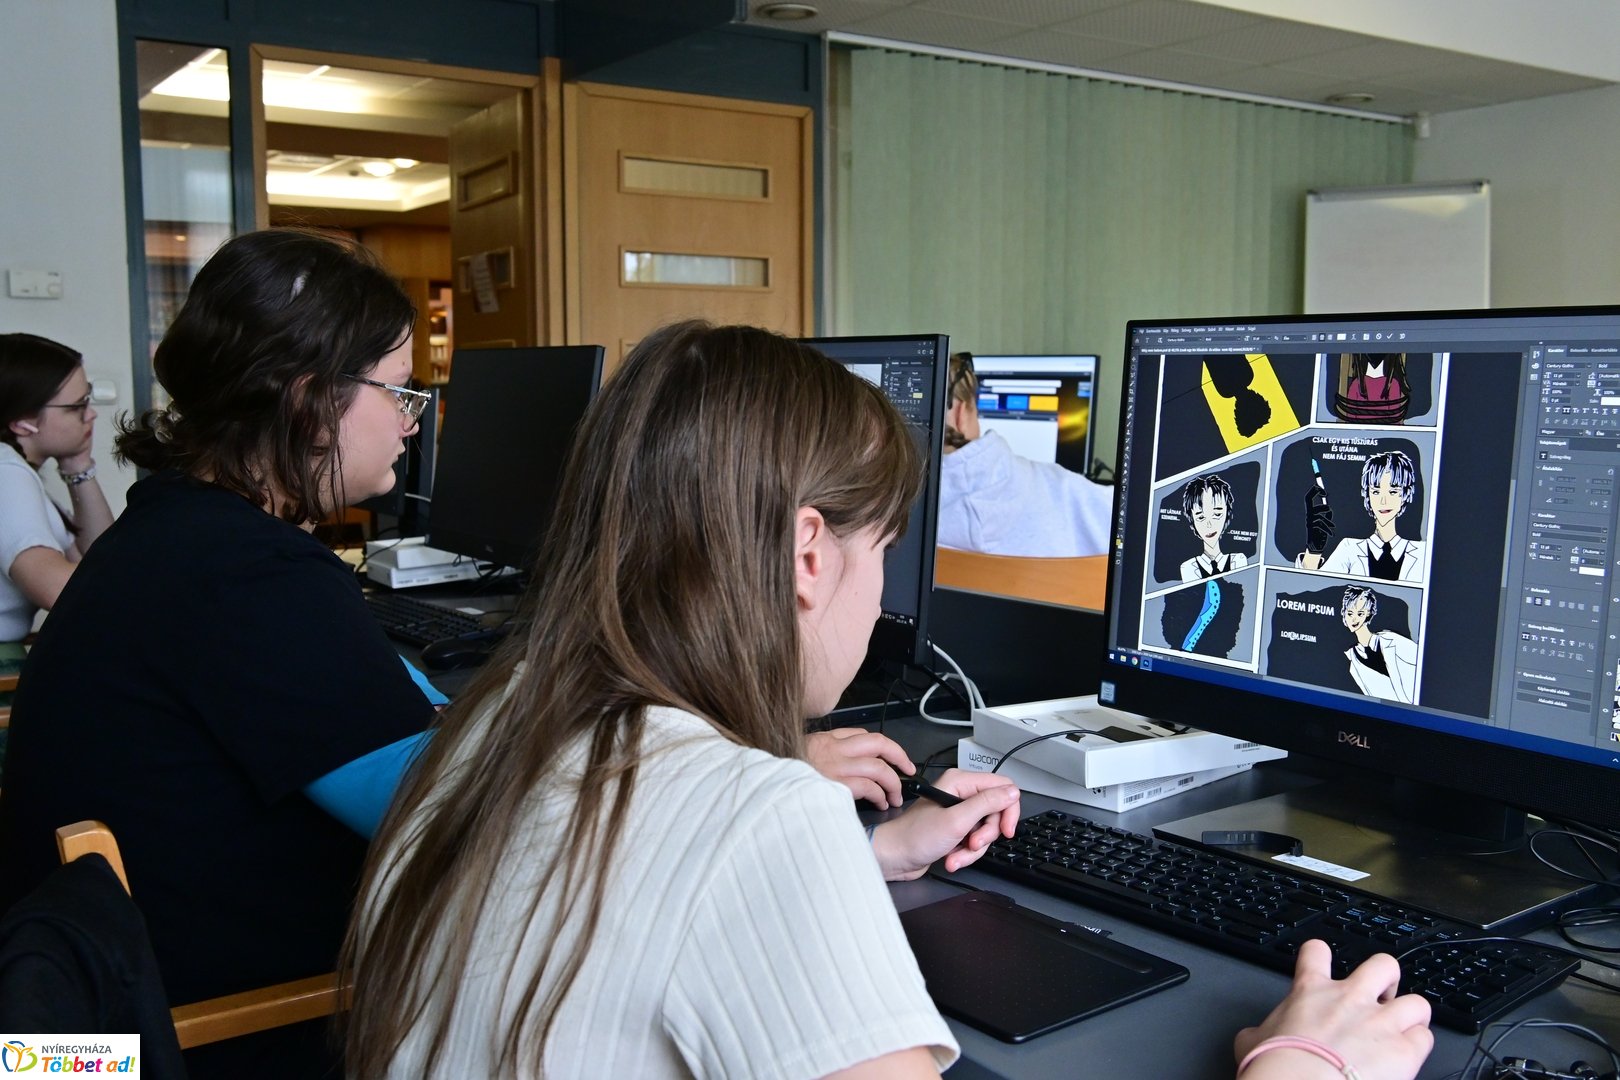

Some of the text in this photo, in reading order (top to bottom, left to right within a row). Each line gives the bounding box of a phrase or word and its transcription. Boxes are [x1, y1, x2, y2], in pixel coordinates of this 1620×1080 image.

[1336, 452, 1346, 460] FÁJ
[1338, 445, 1358, 453] UTÁNA
[1276, 599, 1334, 616] LOREM IPSUM
[1338, 730, 1370, 750] DELL
[969, 752, 1000, 766] wacom
